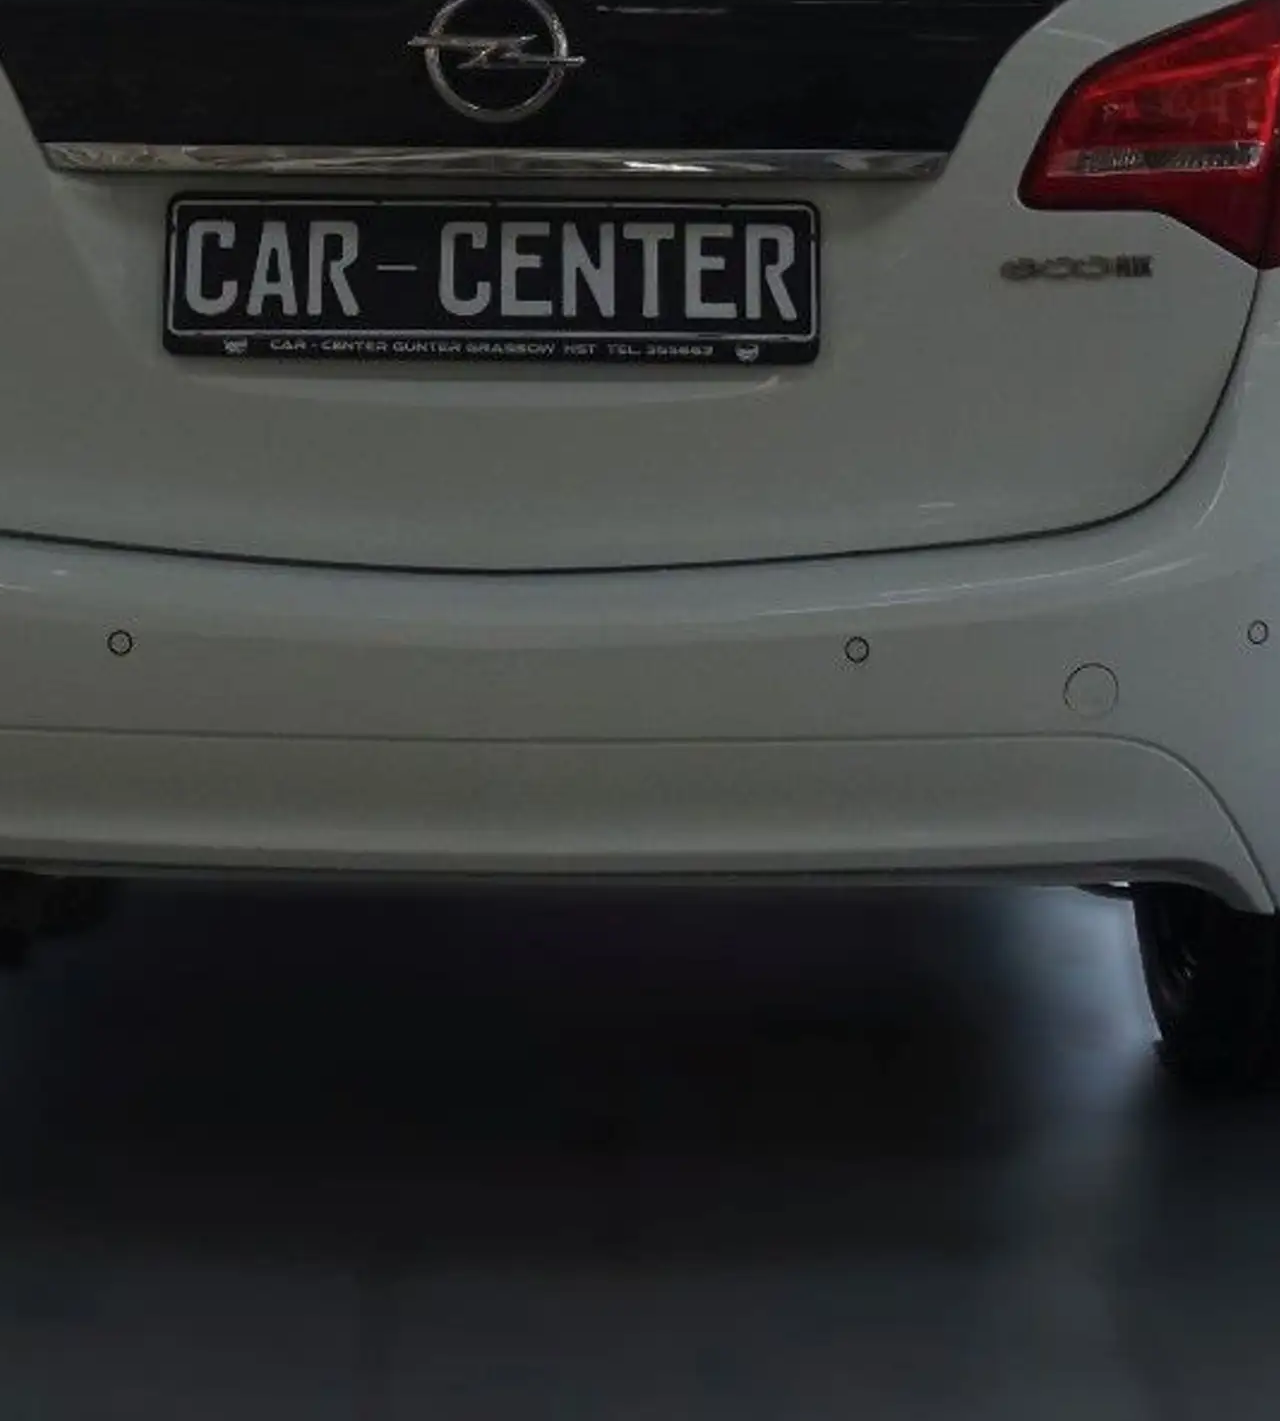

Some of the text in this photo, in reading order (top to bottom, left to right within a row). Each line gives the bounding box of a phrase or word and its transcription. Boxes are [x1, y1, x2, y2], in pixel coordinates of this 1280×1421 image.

[184, 220, 361, 317] CAR
[438, 221, 798, 321] CENTER
[270, 338, 307, 351] CAR
[321, 339, 389, 352] CENTER
